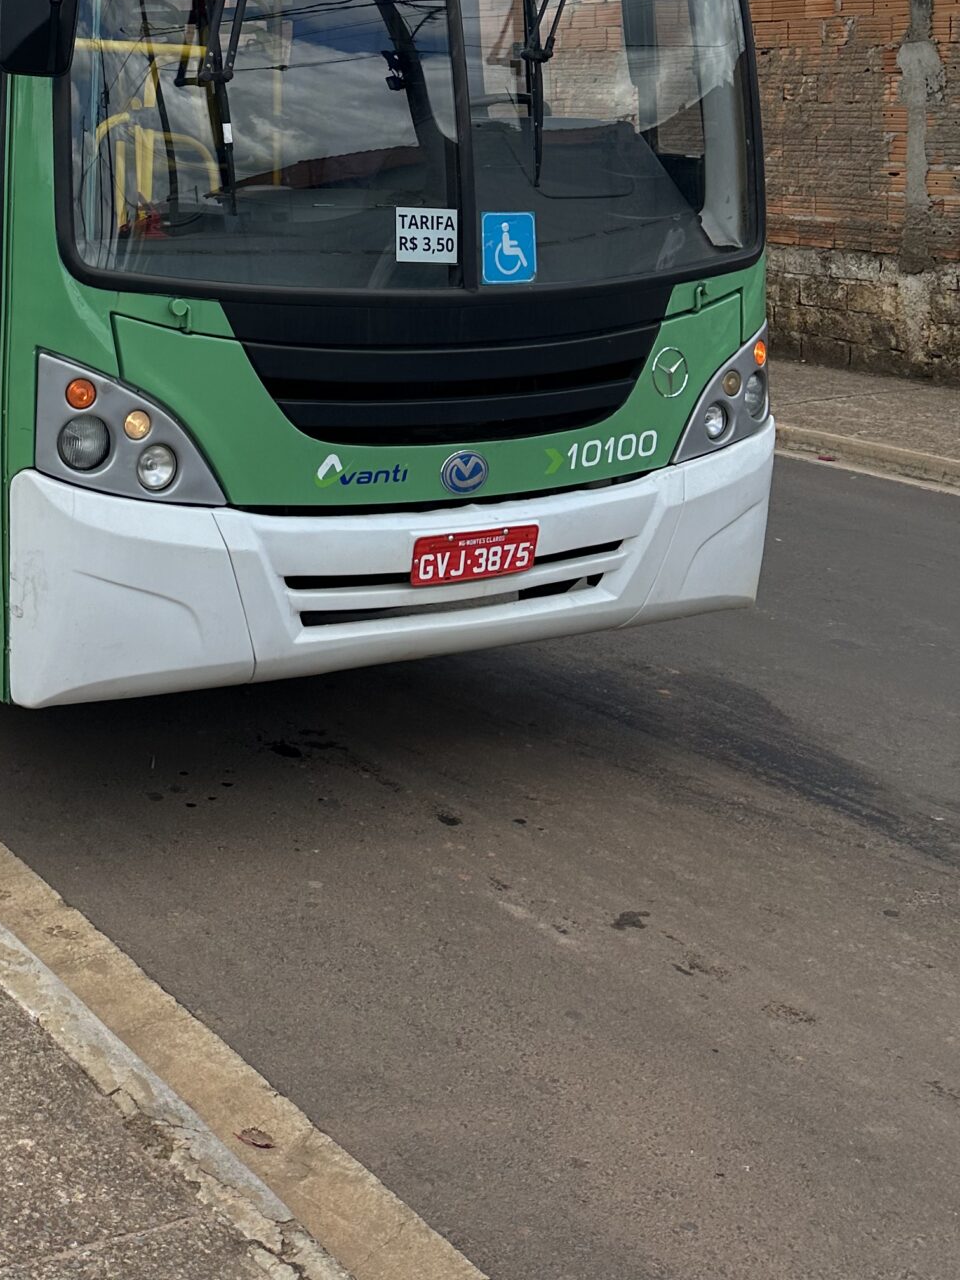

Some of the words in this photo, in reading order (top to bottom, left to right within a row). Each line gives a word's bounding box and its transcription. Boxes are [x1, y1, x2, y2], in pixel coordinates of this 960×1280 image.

[398, 214, 455, 231] TARIFA
[399, 236, 418, 252] R$
[423, 237, 455, 255] 3,50
[567, 430, 658, 470] 10100
